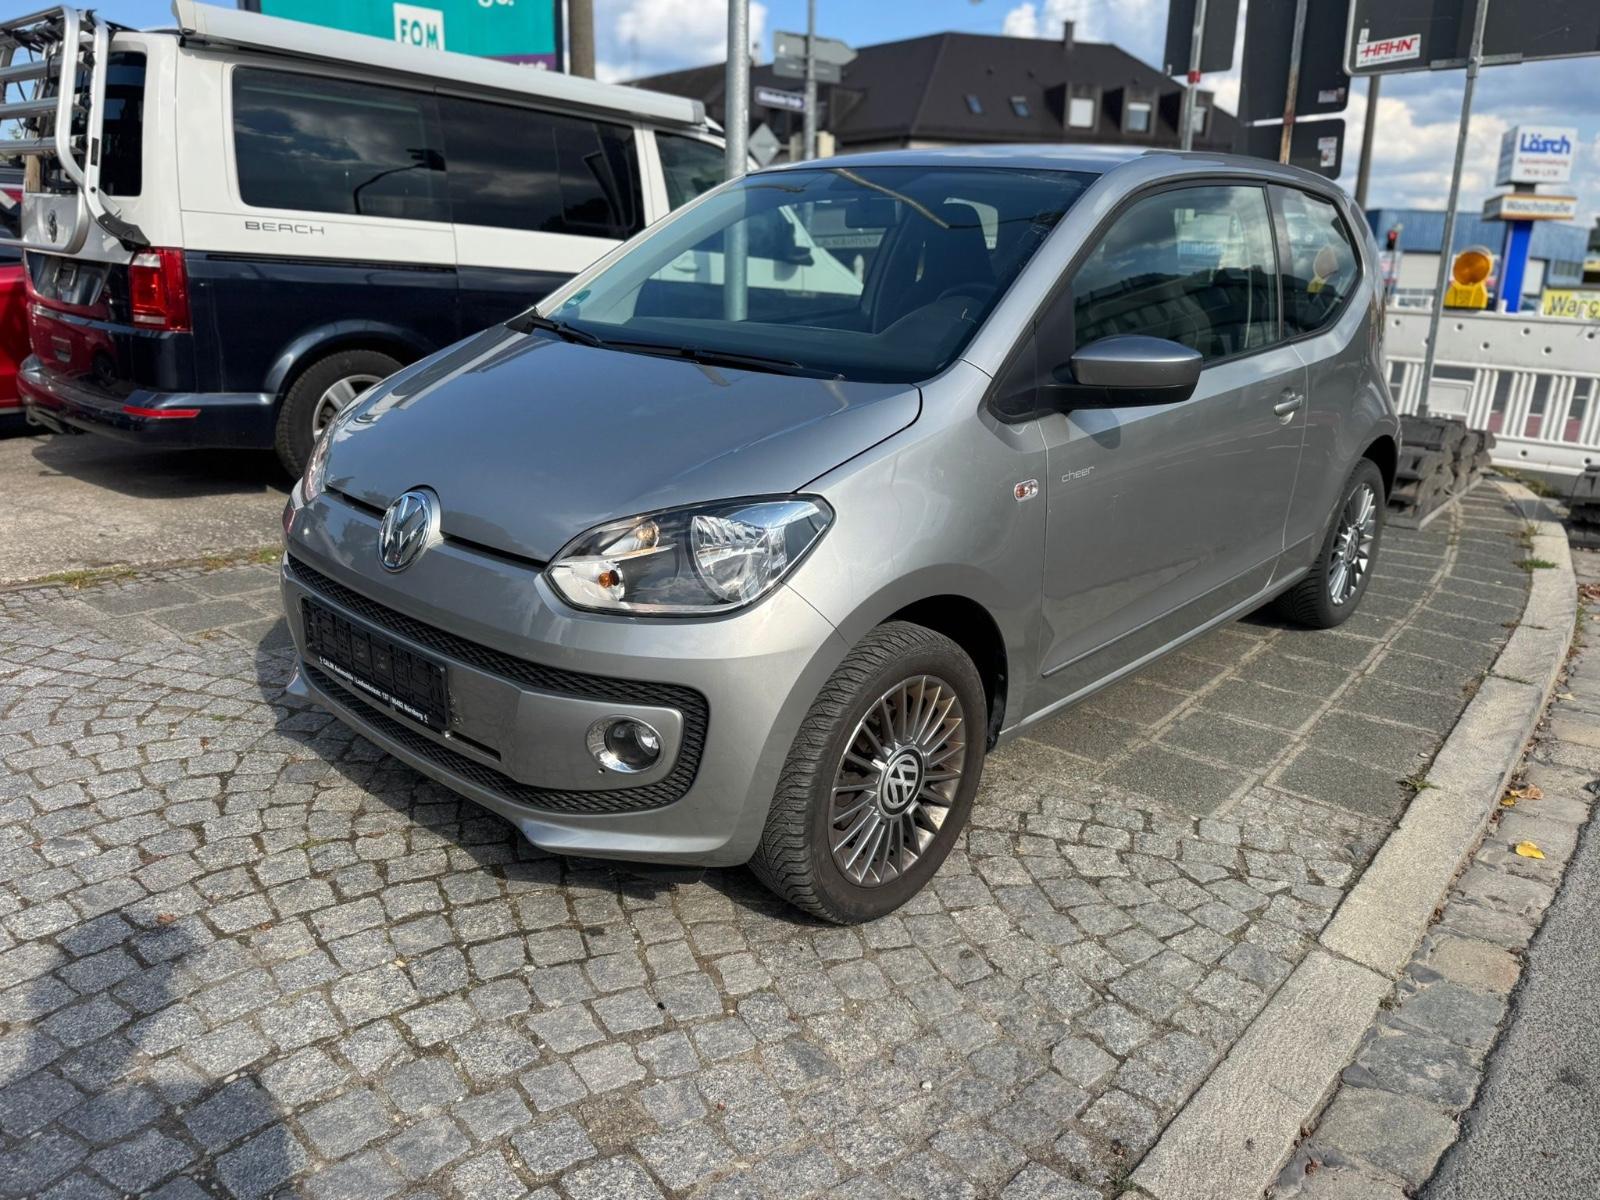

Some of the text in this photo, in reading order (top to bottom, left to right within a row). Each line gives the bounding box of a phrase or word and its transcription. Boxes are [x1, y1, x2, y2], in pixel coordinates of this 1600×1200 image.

[400, 18, 440, 50] FOM
[1361, 37, 1418, 57] HAHN
[1519, 133, 1571, 154] Lösch
[245, 221, 324, 234] BEACH
[1061, 465, 1095, 483] cheer
